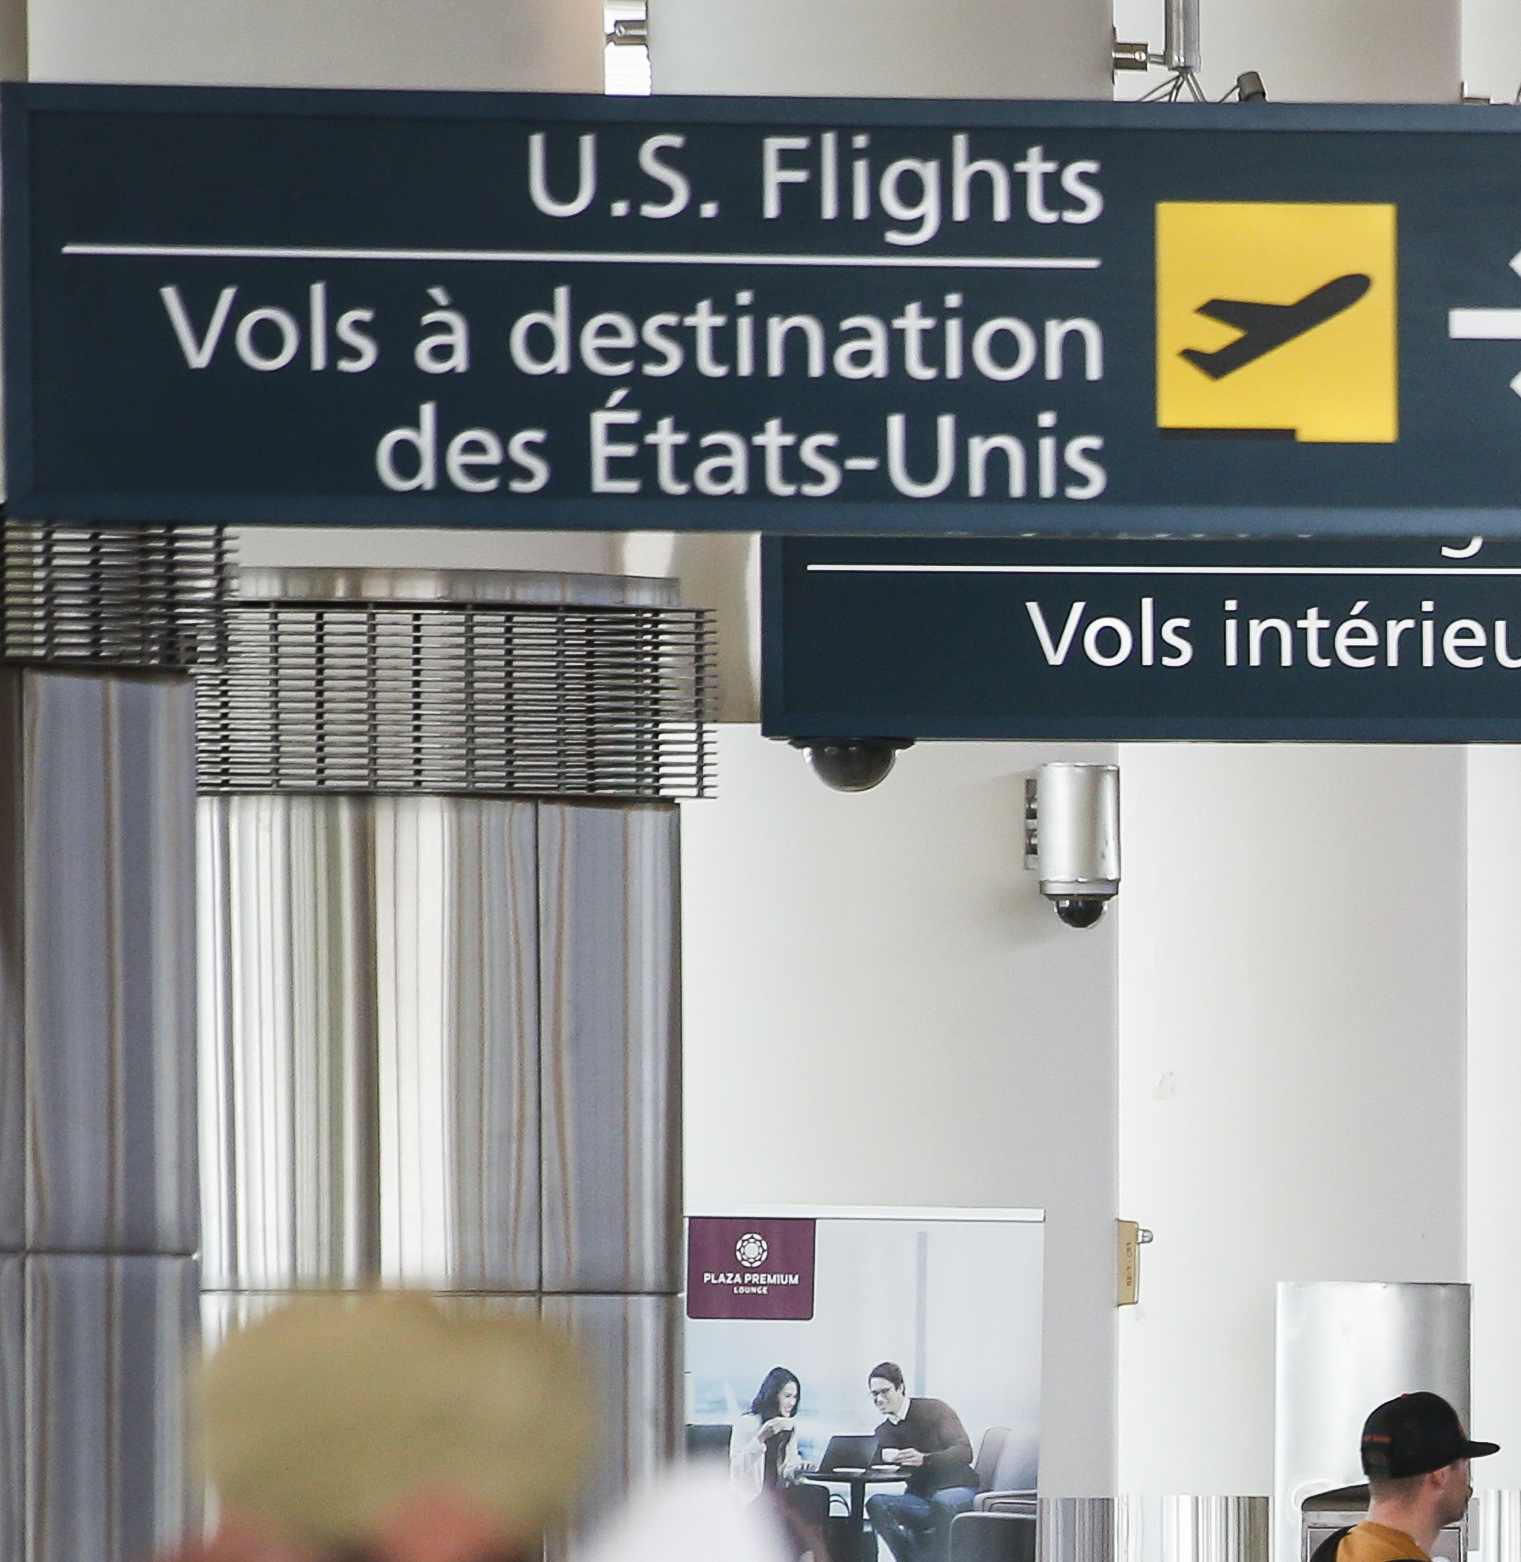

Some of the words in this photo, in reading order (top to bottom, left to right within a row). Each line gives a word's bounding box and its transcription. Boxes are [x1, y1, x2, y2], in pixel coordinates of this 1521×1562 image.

[530, 134, 718, 218] U.S.
[764, 132, 1103, 245] Flights
[160, 283, 377, 372] Vols
[415, 288, 468, 373] à
[510, 286, 1103, 380] destination
[377, 402, 549, 492] des
[591, 389, 1106, 499] États-Unis
[1026, 598, 1192, 666] Vols
[703, 1273, 741, 1284] PLAZA
[745, 1273, 799, 1284] PREMIUM
[734, 1286, 768, 1294] LOUNGE
